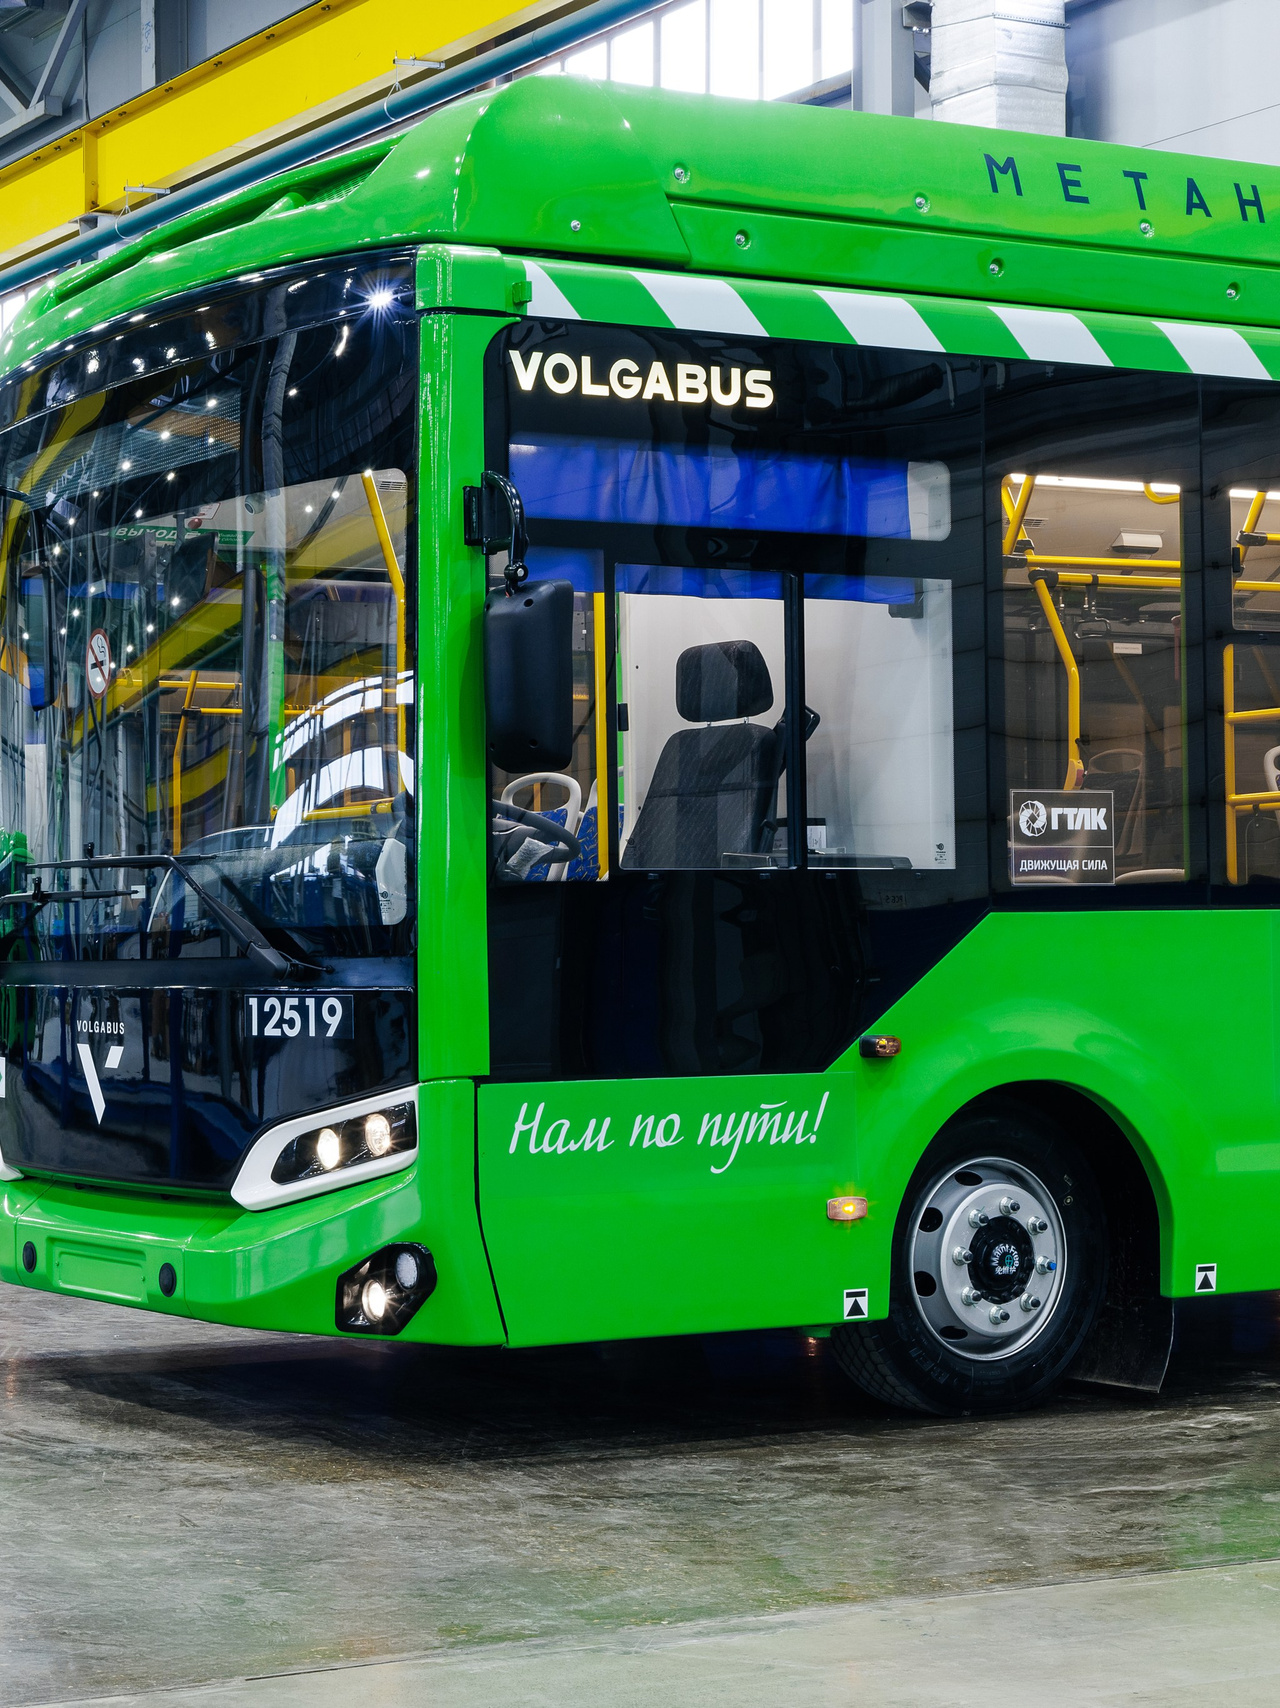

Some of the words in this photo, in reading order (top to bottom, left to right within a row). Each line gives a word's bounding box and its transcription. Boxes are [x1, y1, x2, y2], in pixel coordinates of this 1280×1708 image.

[984, 152, 1266, 224] МЕТАН
[508, 349, 775, 409] VOLGABUS
[1051, 808, 1107, 830] ГТЛК
[1019, 859, 1079, 872] ДВИЖУЩАЯ
[1082, 859, 1107, 870] СИЛА
[76, 1019, 125, 1035] VOLGABUS
[248, 996, 344, 1038] 12519
[509, 1101, 615, 1155] Нам
[628, 1112, 684, 1148] по
[697, 1090, 830, 1174] пути!
